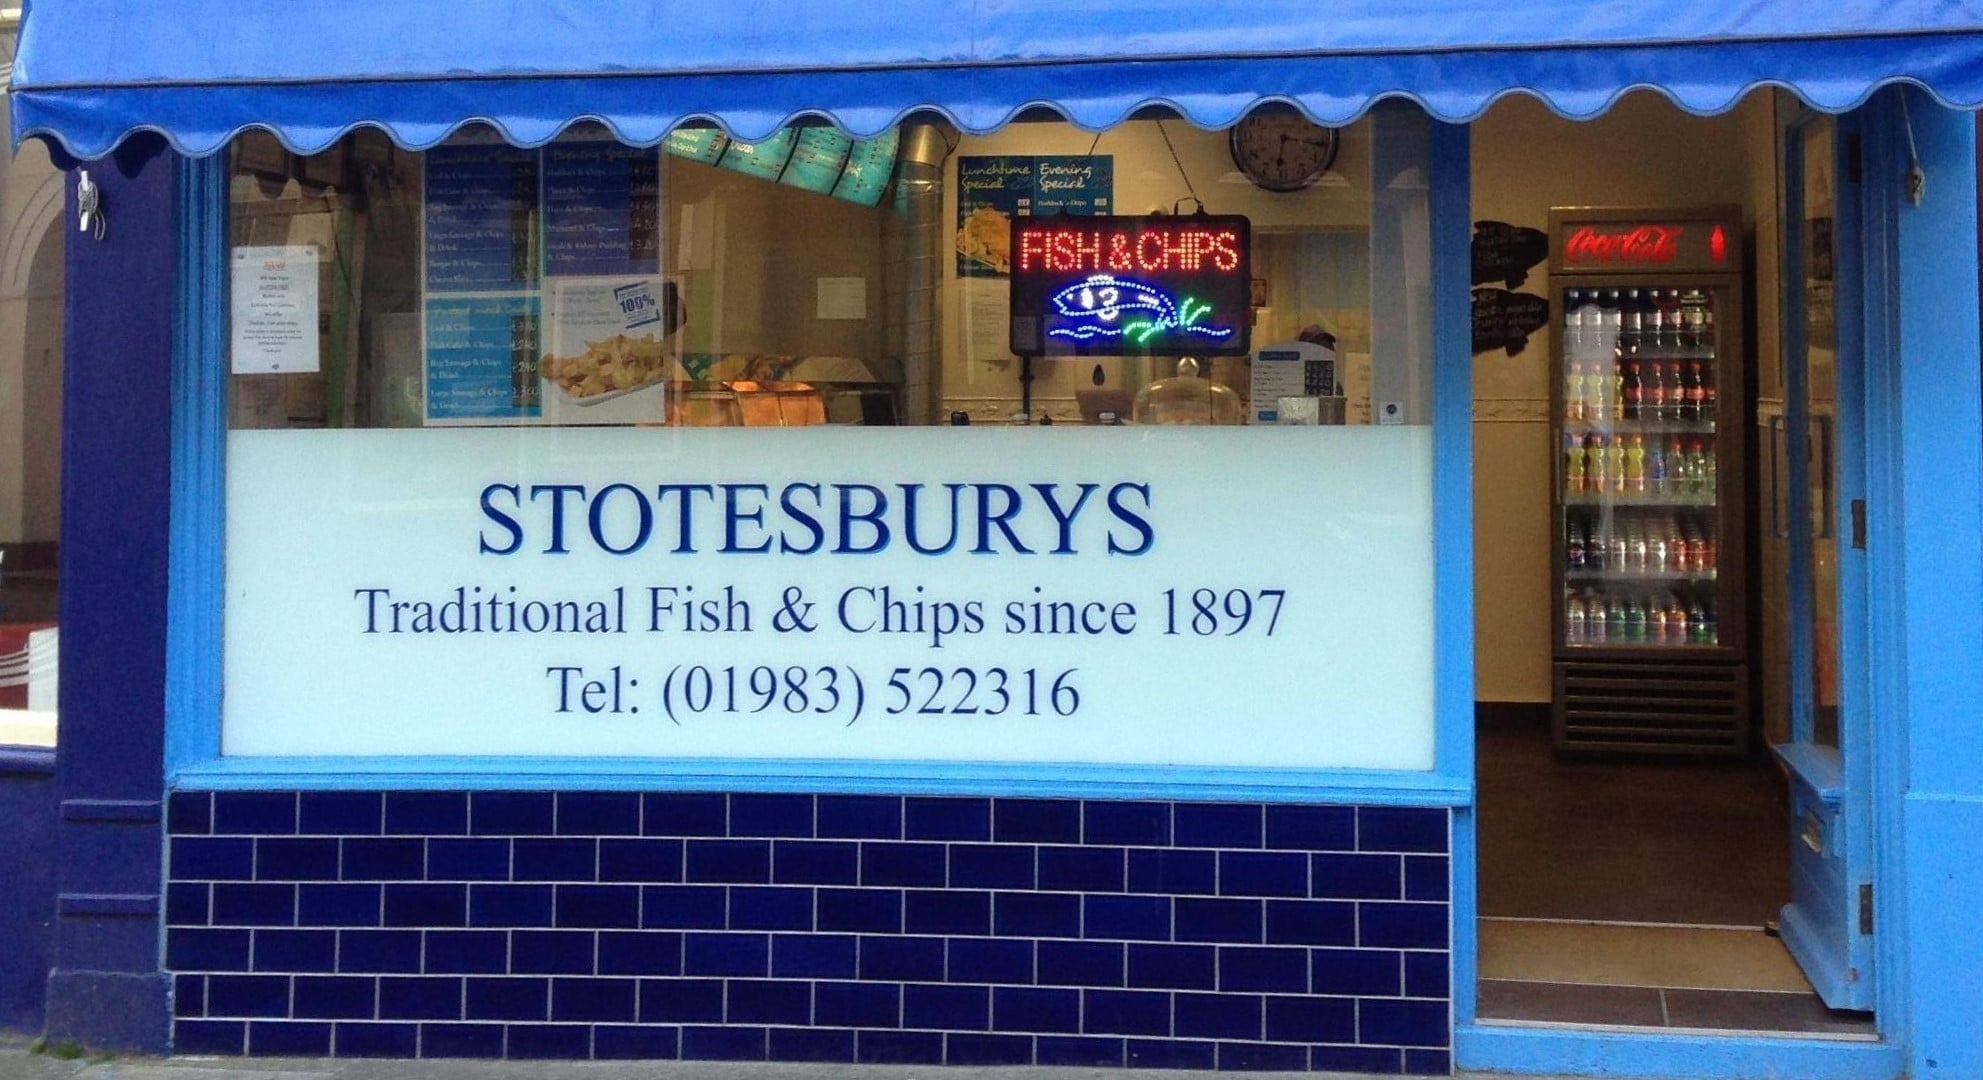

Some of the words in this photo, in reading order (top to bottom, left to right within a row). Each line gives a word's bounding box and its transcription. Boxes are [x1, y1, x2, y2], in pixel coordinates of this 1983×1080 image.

[961, 162, 1031, 176] Lunchtime
[1039, 163, 1092, 178] Evening
[1039, 175, 1086, 192] Special
[961, 176, 1005, 193] Special
[1021, 231, 1100, 270] FISH
[1109, 233, 1132, 270] &
[1137, 231, 1239, 270] CHIPS
[1565, 225, 1683, 263] Coca-Cola
[619, 293, 655, 314] 100%
[480, 482, 1154, 556] STOTESBURYS
[355, 586, 626, 633] Traditional
[647, 585, 753, 632] Fish
[773, 586, 817, 632] &
[838, 586, 984, 647] Chips
[1006, 587, 1136, 634] since
[1164, 588, 1285, 636] 1897
[547, 666, 638, 713] Tel:
[664, 666, 864, 726] (01983)
[886, 667, 1079, 716] 522316
